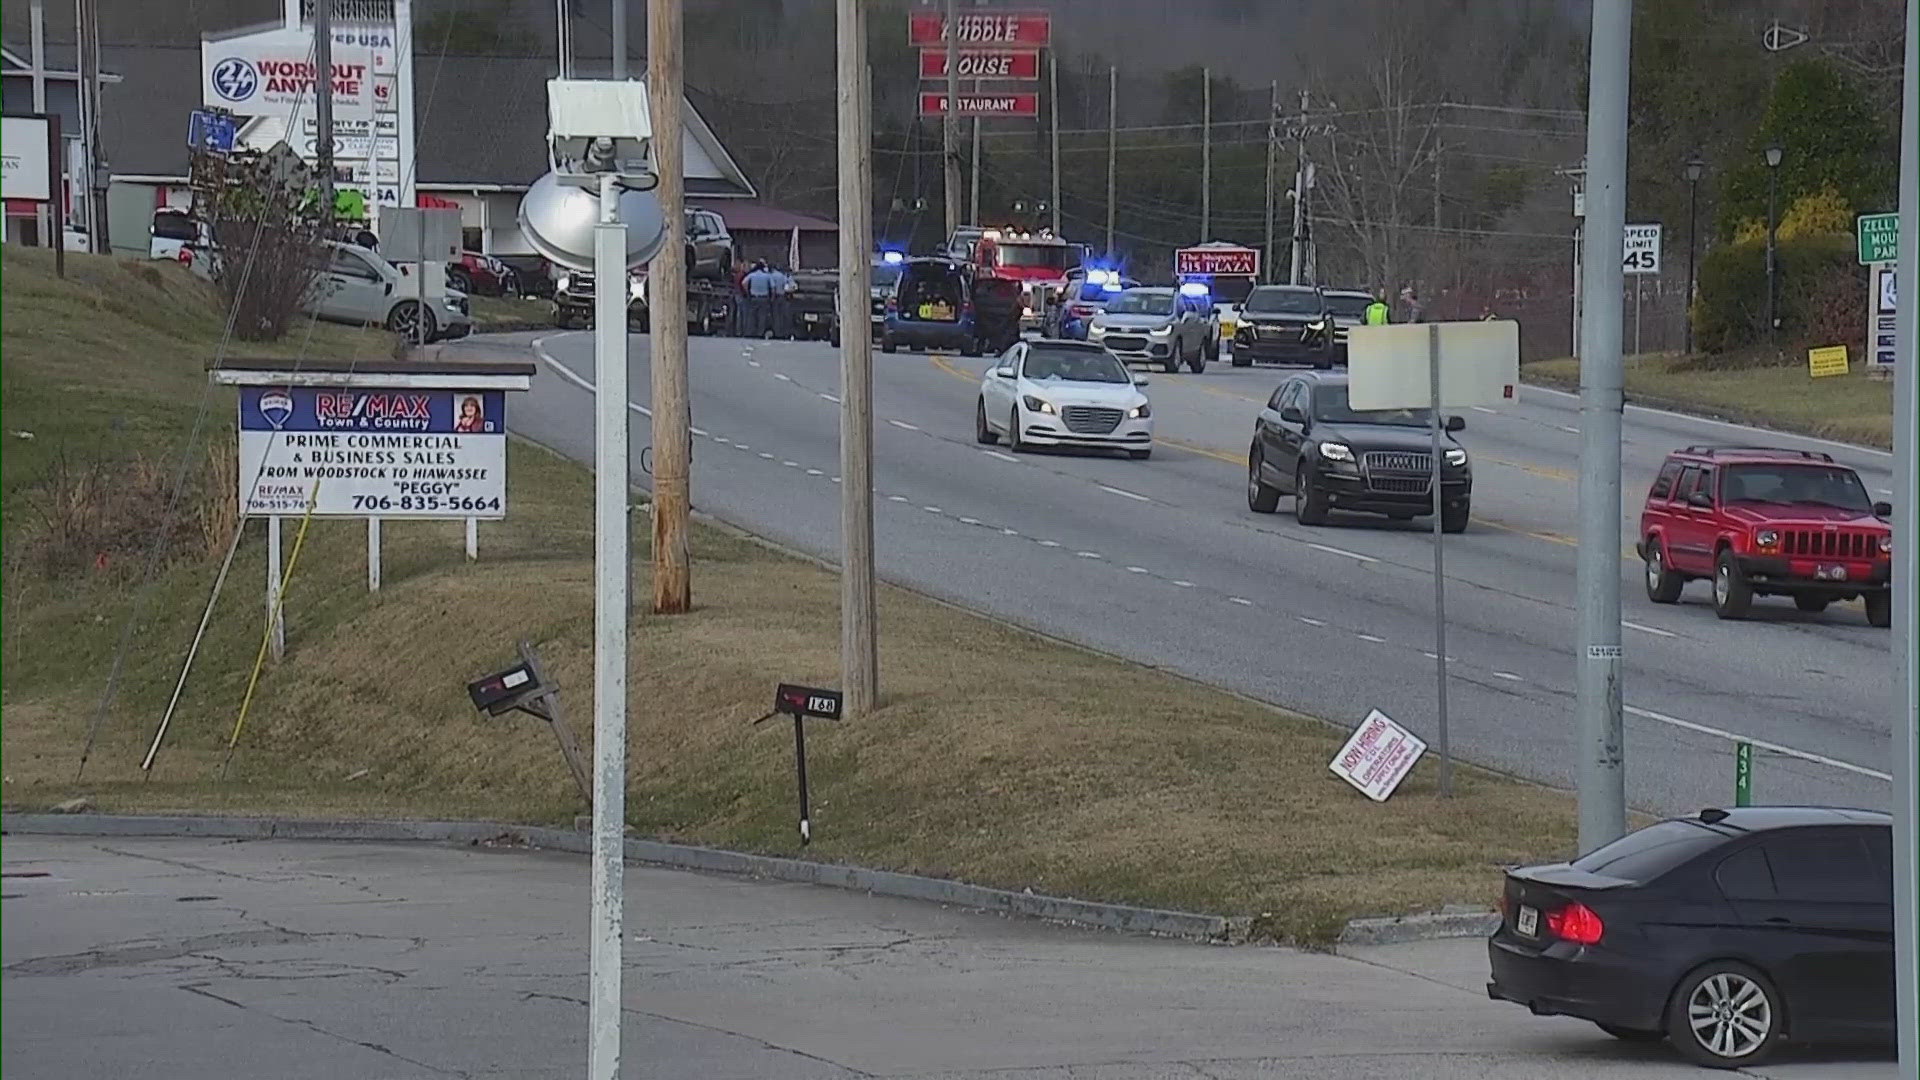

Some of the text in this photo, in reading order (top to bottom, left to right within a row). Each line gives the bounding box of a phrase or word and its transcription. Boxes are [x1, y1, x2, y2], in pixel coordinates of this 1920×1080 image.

[359, 34, 391, 48] USA
[265, 78, 359, 95] ANYTME
[940, 98, 1015, 110] RSTAURANT
[1863, 219, 1893, 232] ZELL
[1626, 240, 1652, 249] LIMIT
[1871, 232, 1898, 246] MOU
[1181, 252, 1199, 260] The
[1623, 251, 1655, 269] 45
[1181, 261, 1252, 272] 515 PLAZA
[316, 394, 431, 418] RE/MAX
[318, 417, 429, 430] Town & Country
[286, 435, 462, 449] PRIME COMMERCIAL
[293, 451, 456, 465] & BUSINESS SALES
[259, 466, 487, 480] FROM WOODSTOCK TO HIAWASSEE
[351, 495, 500, 511] 706-835-5664
[1339, 717, 1387, 771] NOW HIRING
[1738, 745, 1748, 789] 434
